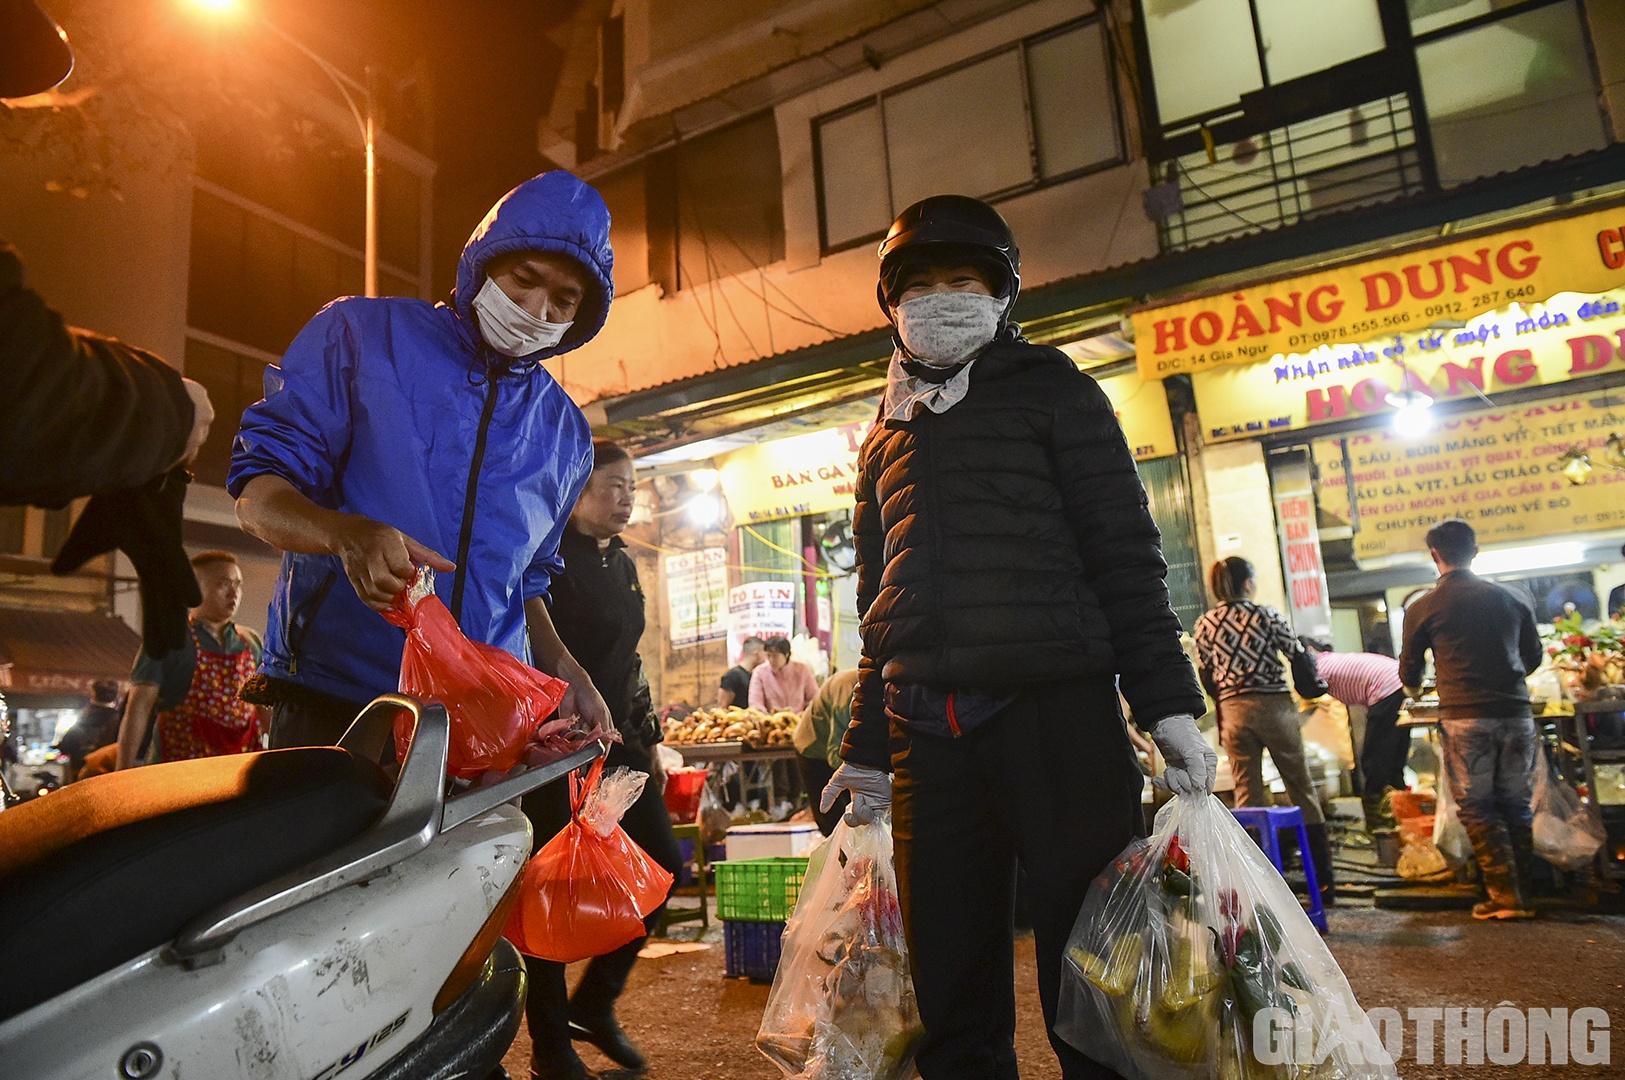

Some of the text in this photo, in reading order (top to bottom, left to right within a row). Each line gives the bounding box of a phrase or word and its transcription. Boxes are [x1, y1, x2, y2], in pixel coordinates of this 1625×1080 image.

[1597, 226, 1625, 270] C
[1153, 239, 1542, 354] HOÀNG DUNG
[1190, 353, 1206, 364] 14
[1210, 350, 1234, 362] Gia
[1306, 349, 1537, 422] HOÀNG
[837, 420, 877, 453] T
